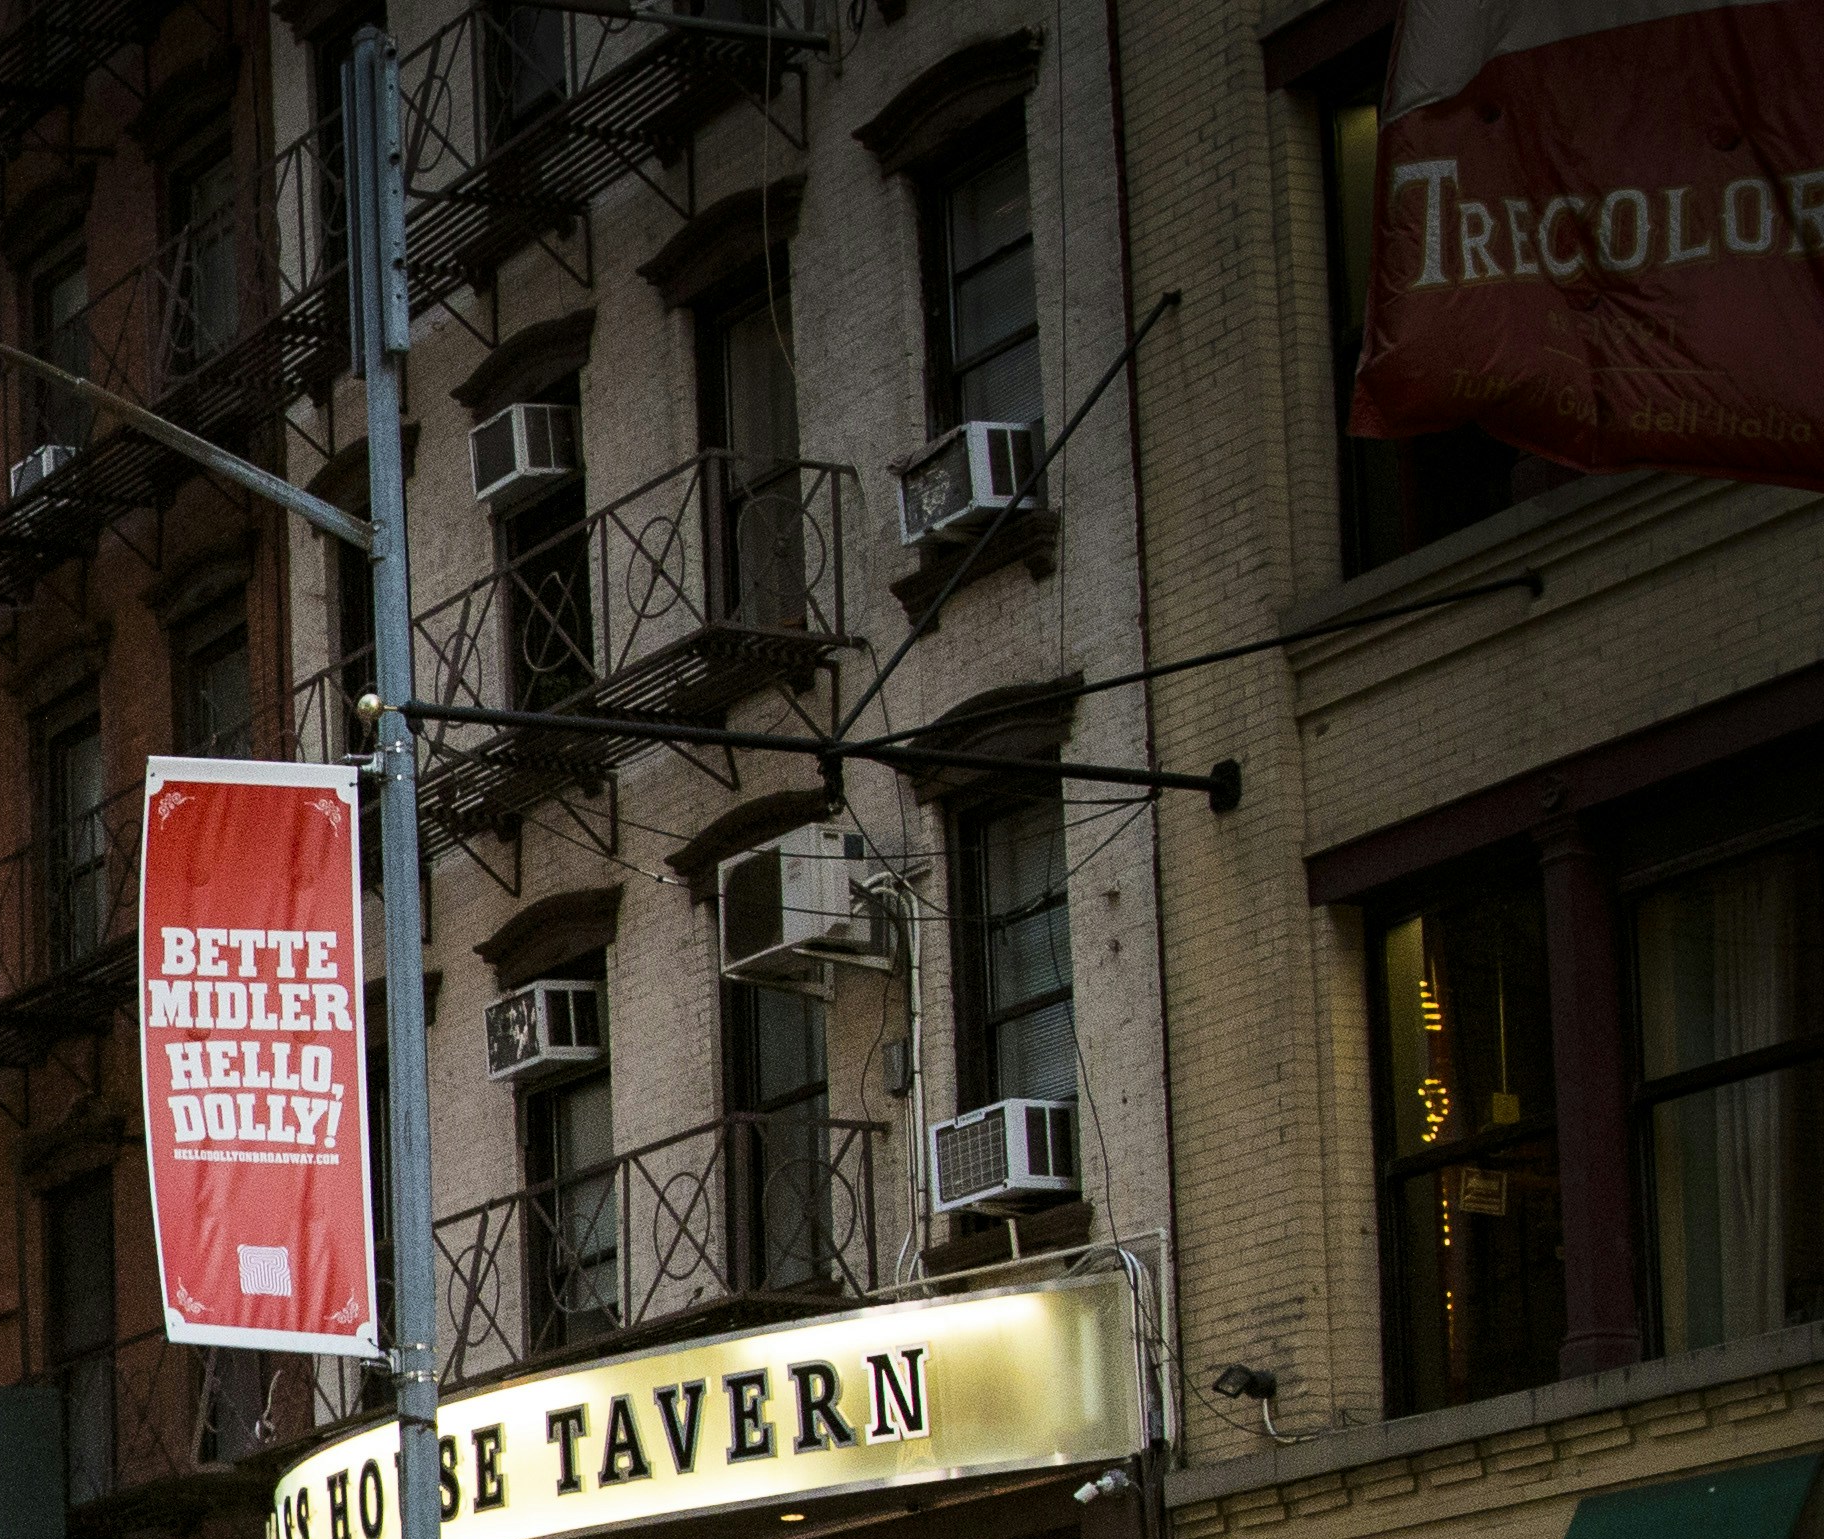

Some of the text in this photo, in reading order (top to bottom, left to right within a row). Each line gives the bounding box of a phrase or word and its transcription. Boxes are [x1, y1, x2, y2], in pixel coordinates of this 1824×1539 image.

[162, 927, 337, 980] BETTE
[149, 980, 353, 1031] MIDLER
[167, 1041, 344, 1098] HELLO,
[167, 1092, 341, 1148] DOLLY!
[546, 1342, 931, 1494] TAVERN
